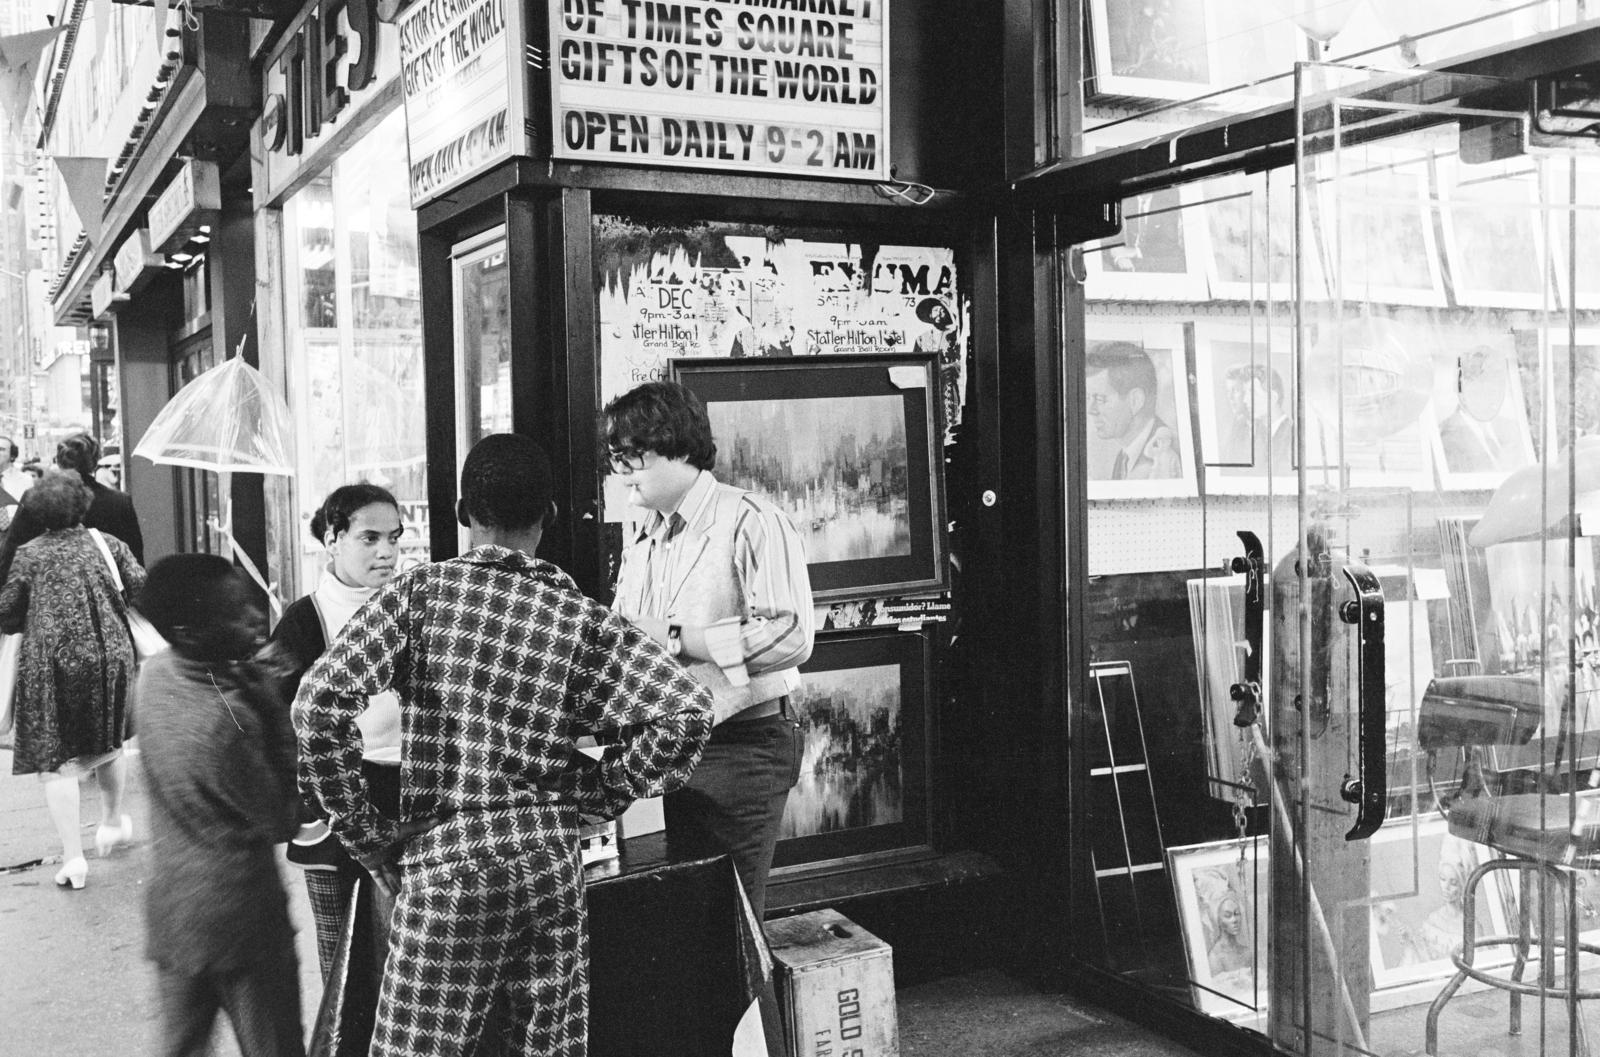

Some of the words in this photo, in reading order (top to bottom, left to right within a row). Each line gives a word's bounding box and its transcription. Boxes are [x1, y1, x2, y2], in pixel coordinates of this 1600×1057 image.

[564, 0, 604, 34] OF
[621, 0, 724, 47] TIMES
[737, 11, 854, 60] SQUARE
[404, 47, 434, 97] GIFTS
[432, 36, 447, 78] OF
[449, 18, 470, 67] THE
[561, 39, 658, 86] GIFTS
[664, 49, 703, 90] OF
[709, 54, 769, 97] THE
[774, 60, 878, 105] WORLD
[434, 134, 467, 185] DAILY
[564, 110, 650, 153] OPEN
[662, 118, 754, 161] DAILY
[767, 125, 824, 168] 9-2
[833, 131, 877, 171] AM
[658, 287, 694, 310] DEC
[658, 323, 692, 340] Hilton
[807, 329, 846, 346] Statler
[847, 330, 877, 345] Hilton
[838, 988, 862, 1041] GOLD
